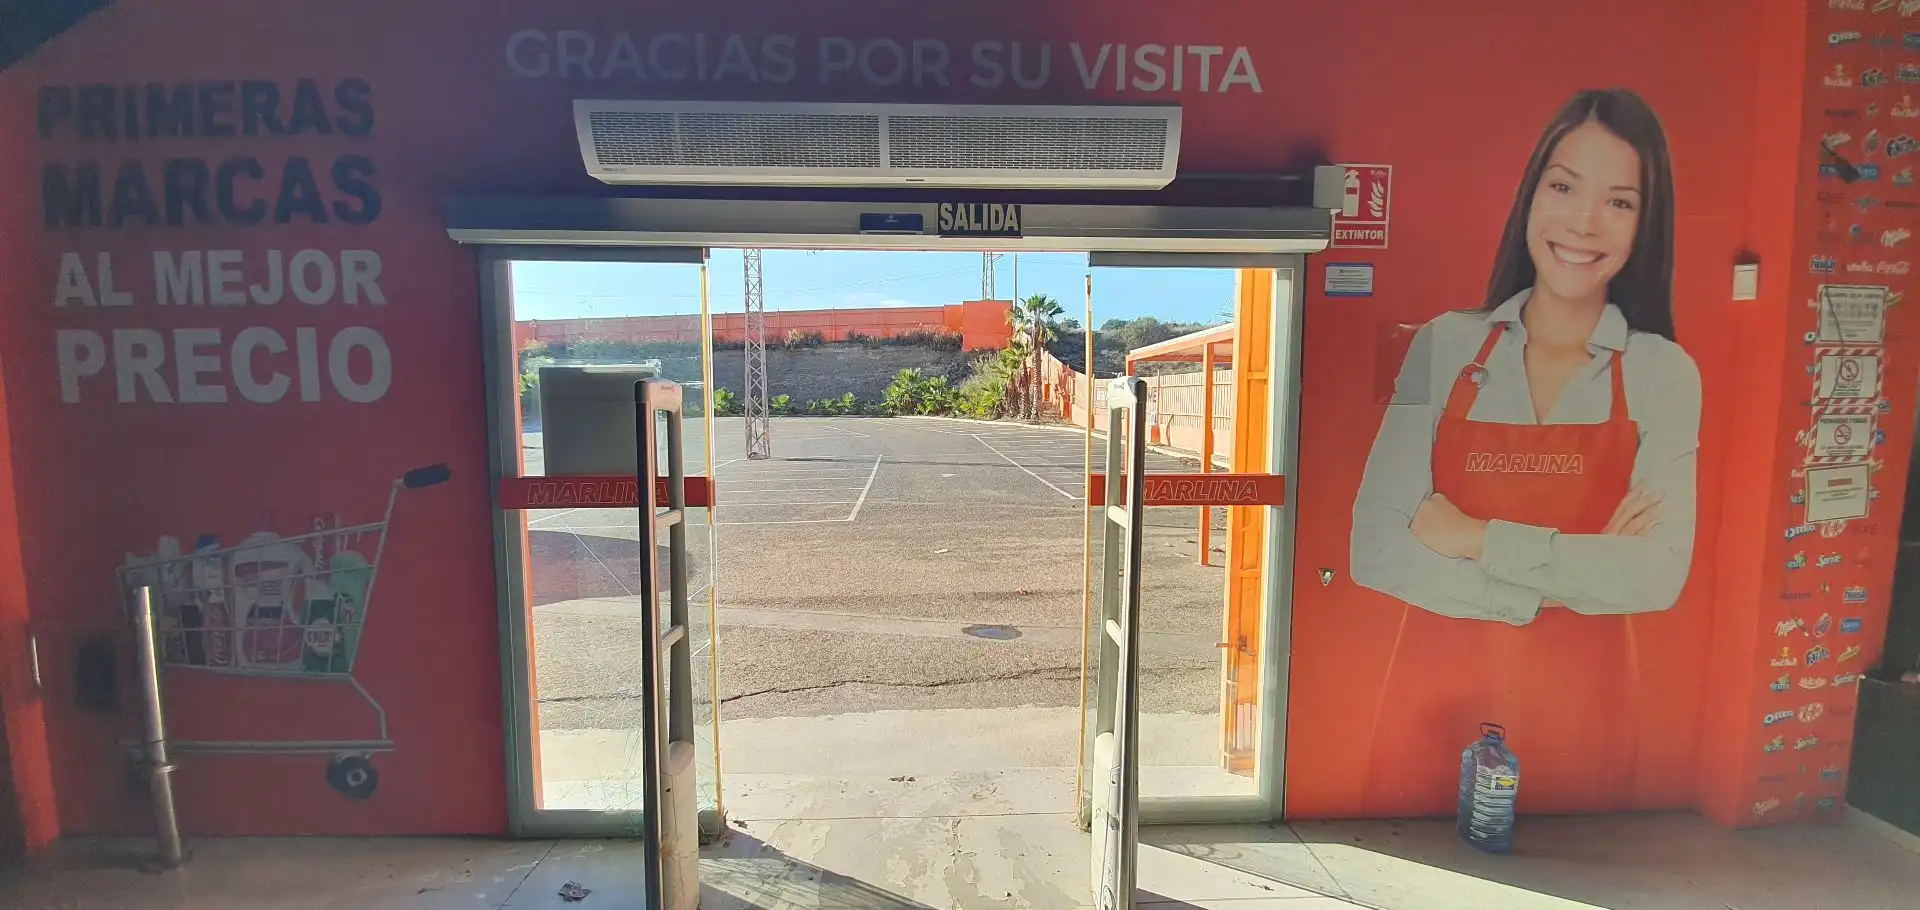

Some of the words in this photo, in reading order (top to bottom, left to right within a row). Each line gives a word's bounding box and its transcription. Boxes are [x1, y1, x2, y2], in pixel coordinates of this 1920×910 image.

[505, 29, 796, 84] GRACIAS
[818, 37, 950, 88] POR
[969, 39, 1051, 89] SU
[1069, 42, 1263, 94] VISITA
[37, 78, 375, 140] PRIMERAS
[42, 155, 382, 229] MARCAS
[940, 203, 1019, 231] SALIDA
[1335, 229, 1384, 240] EXTINTOR
[54, 252, 135, 308] AL
[154, 249, 387, 307] MEJOR
[56, 326, 392, 404] PRECIO
[1466, 453, 1583, 475] MARLINA
[1763, 709, 1794, 726] OREO
